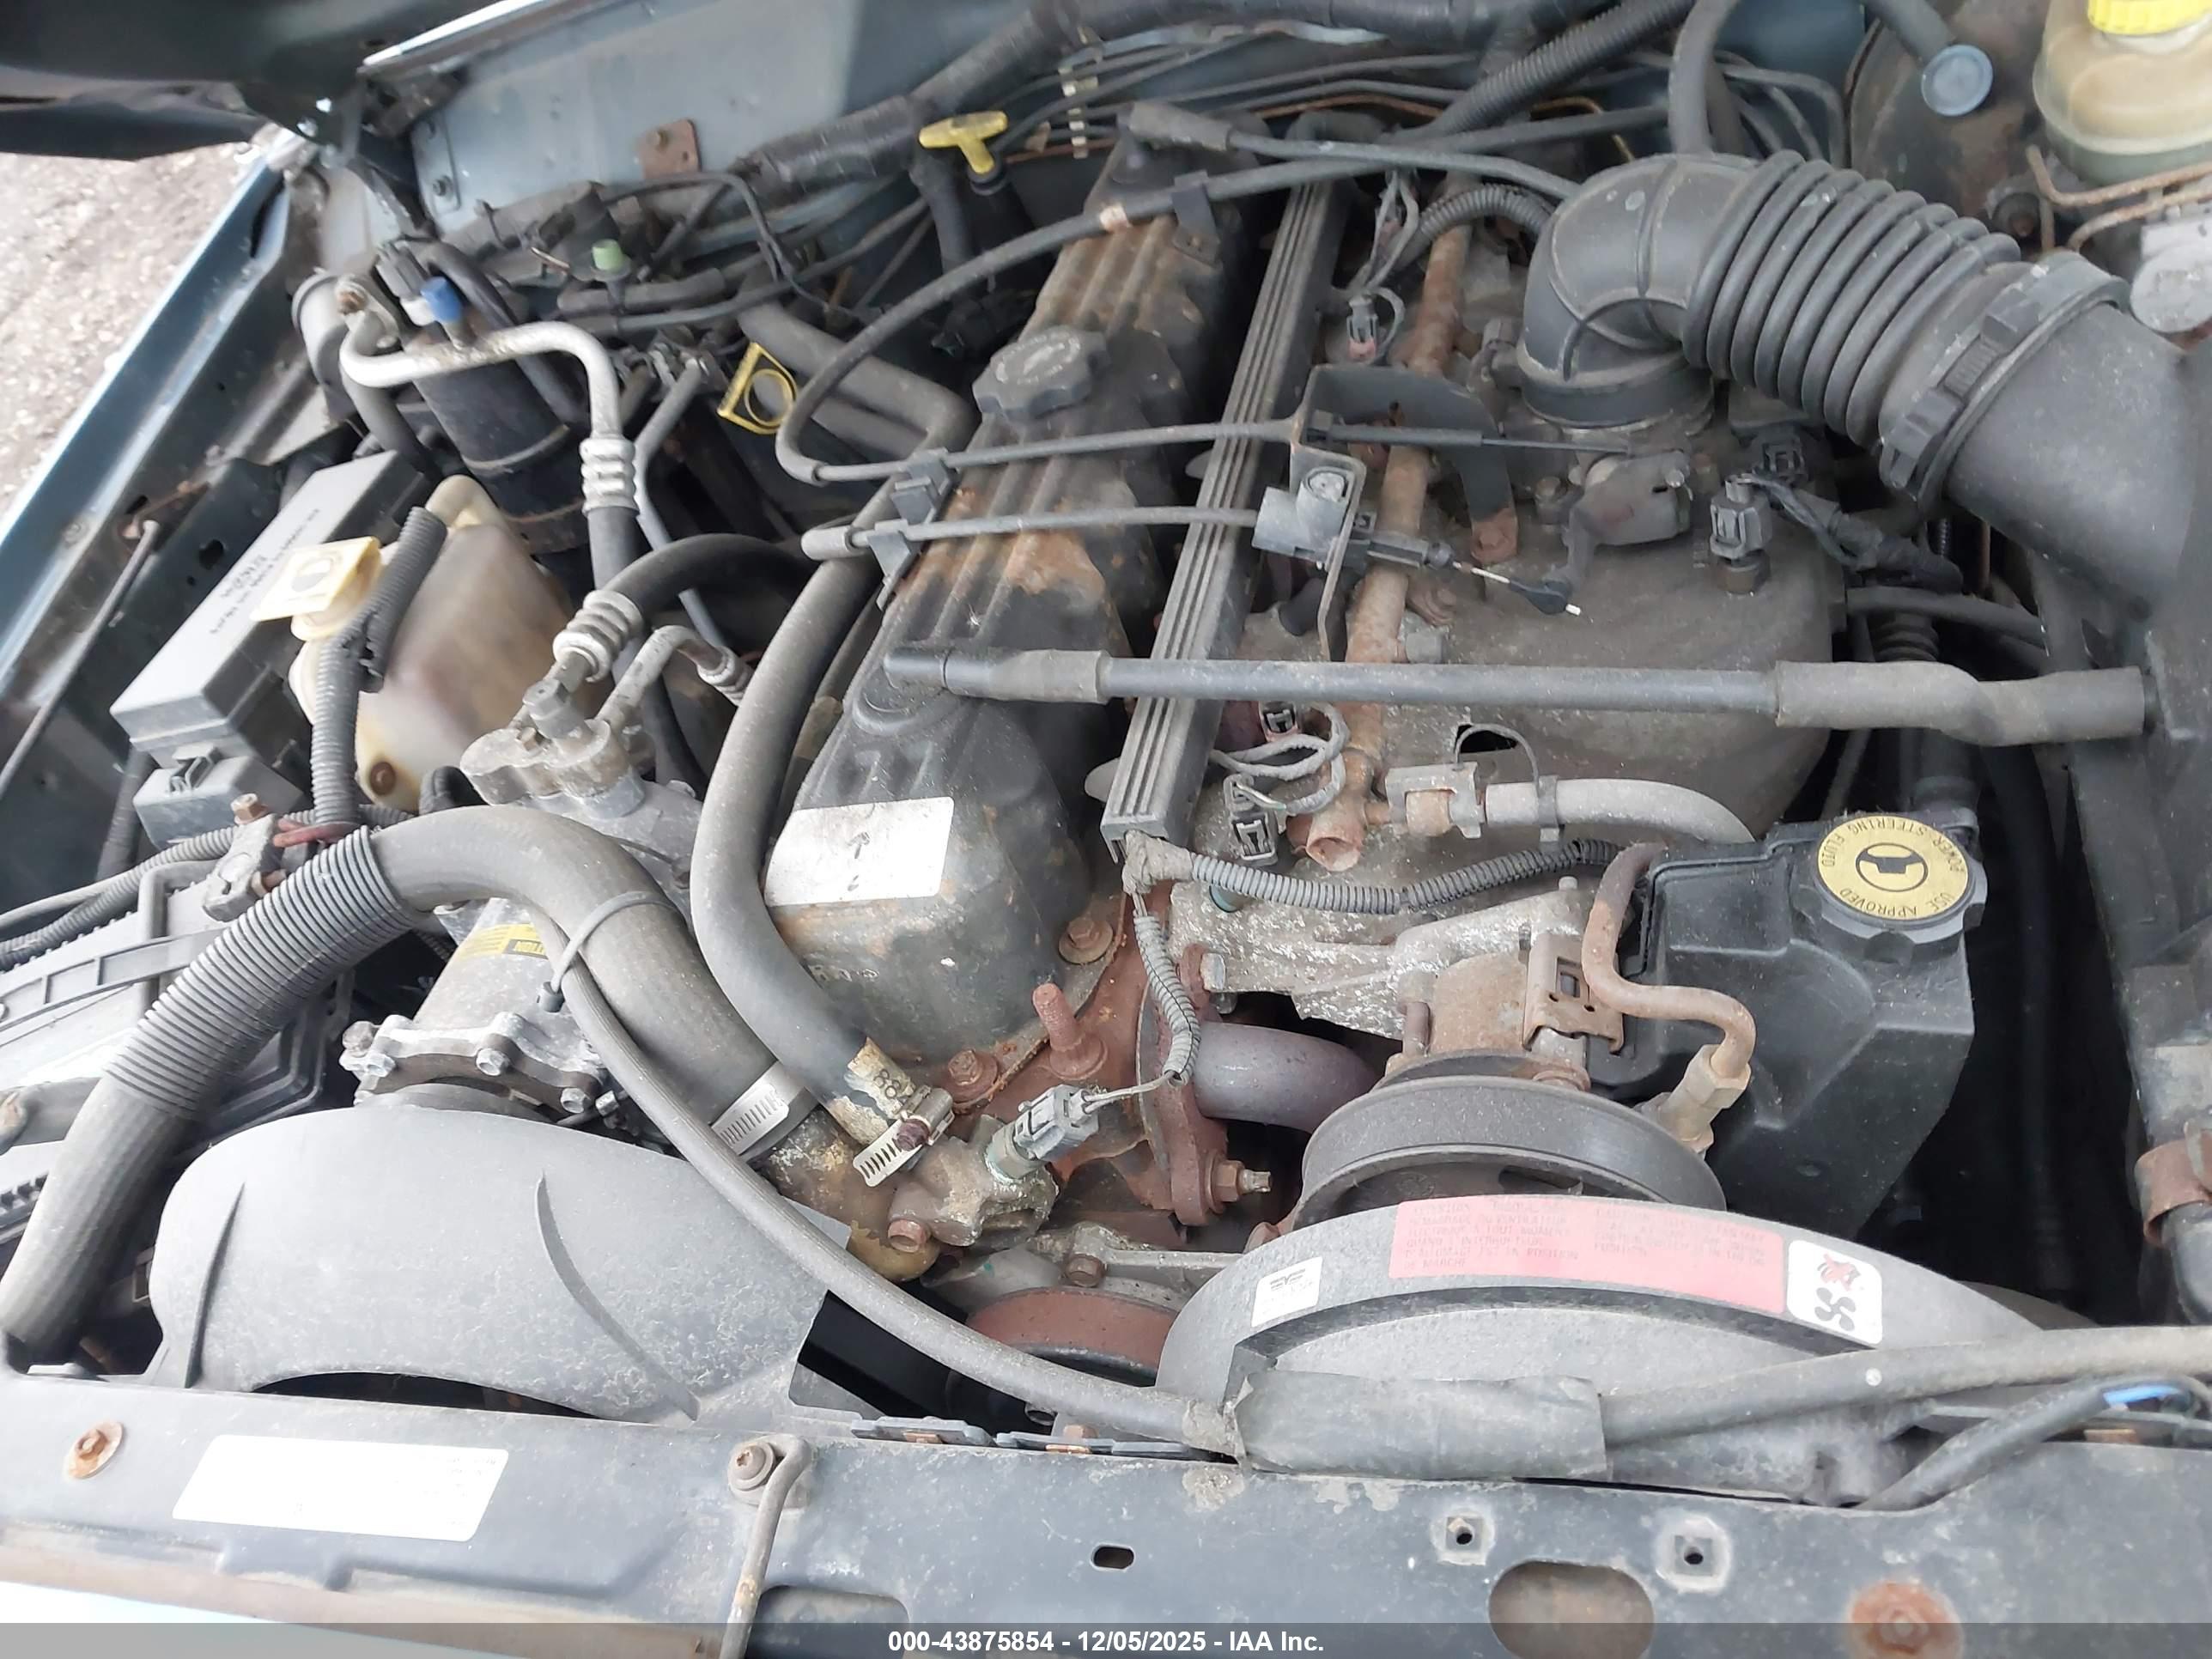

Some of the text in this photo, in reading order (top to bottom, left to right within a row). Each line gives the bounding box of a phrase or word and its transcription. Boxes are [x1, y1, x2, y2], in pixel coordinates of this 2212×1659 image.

[1847, 817, 1929, 838] STEERING
[1820, 833, 1846, 868] FLUID
[1839, 888, 1957, 917] USE APPROVED
